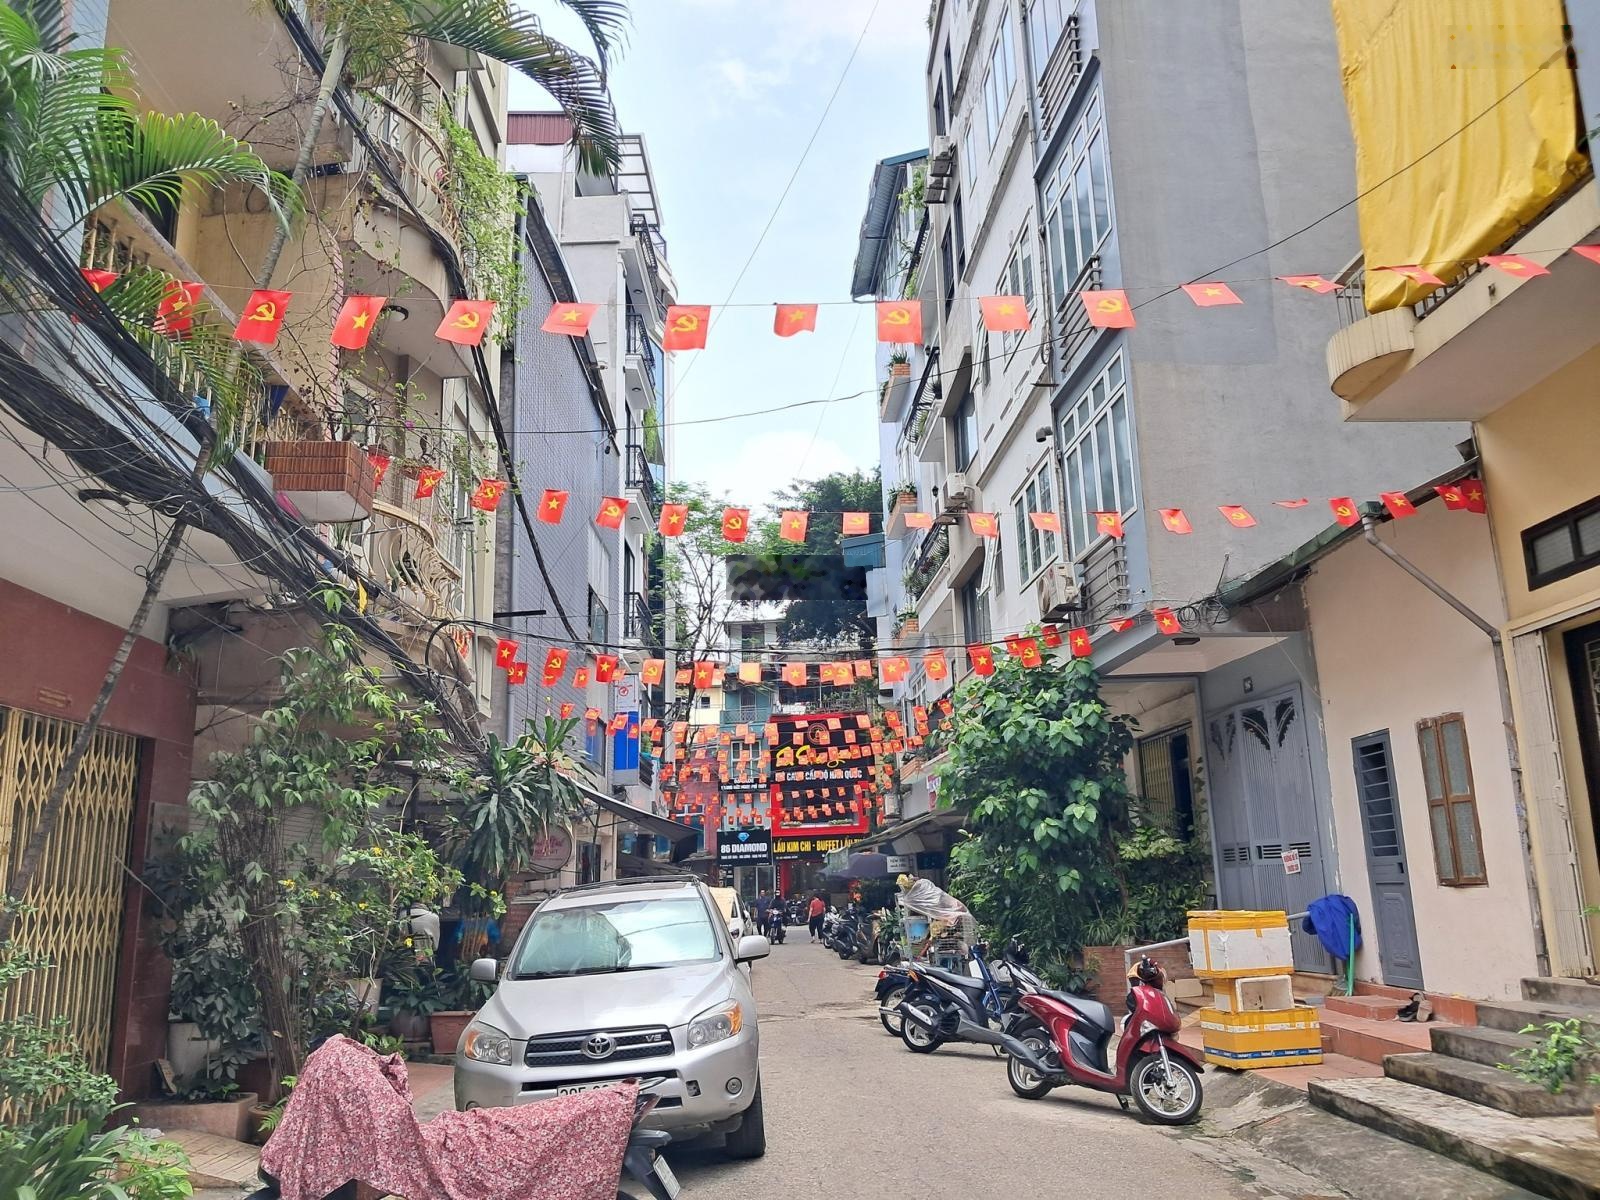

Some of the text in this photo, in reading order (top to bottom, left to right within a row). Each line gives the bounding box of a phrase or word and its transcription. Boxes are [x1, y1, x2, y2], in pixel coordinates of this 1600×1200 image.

[731, 842, 768, 854] DIAMOND
[786, 840, 800, 853] KIM
[799, 840, 812, 852] CHI
[816, 839, 840, 852] BUFFET
